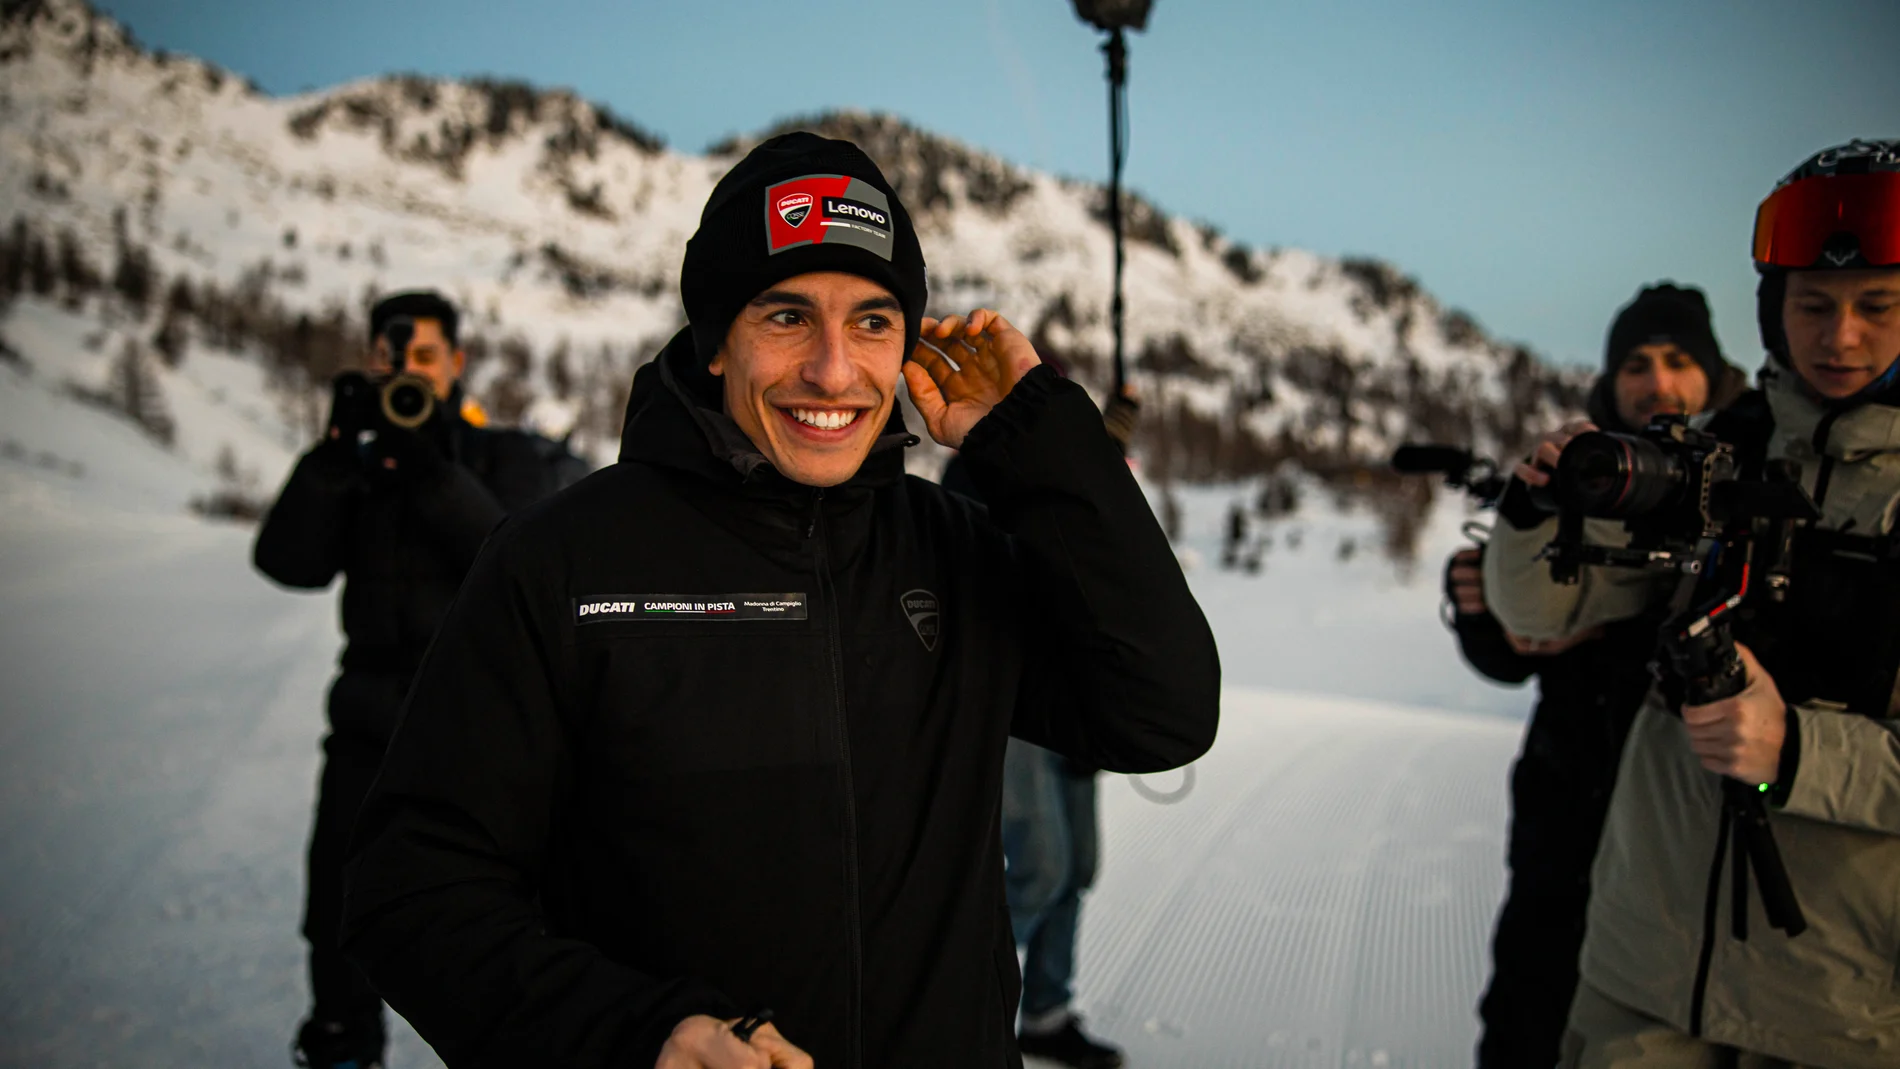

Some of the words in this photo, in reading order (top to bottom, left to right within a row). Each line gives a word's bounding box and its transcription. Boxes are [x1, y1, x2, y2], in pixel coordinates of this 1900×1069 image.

[780, 197, 809, 207] DUCATI
[828, 200, 885, 224] Lenovo
[851, 224, 873, 234] FACTORY
[873, 230, 886, 239] TEAM
[579, 602, 636, 616] DUCATI
[644, 602, 692, 611] CAMPIONI
[694, 602, 706, 611] IN
[707, 602, 735, 611] PISTA
[906, 600, 936, 609] DUCATI
